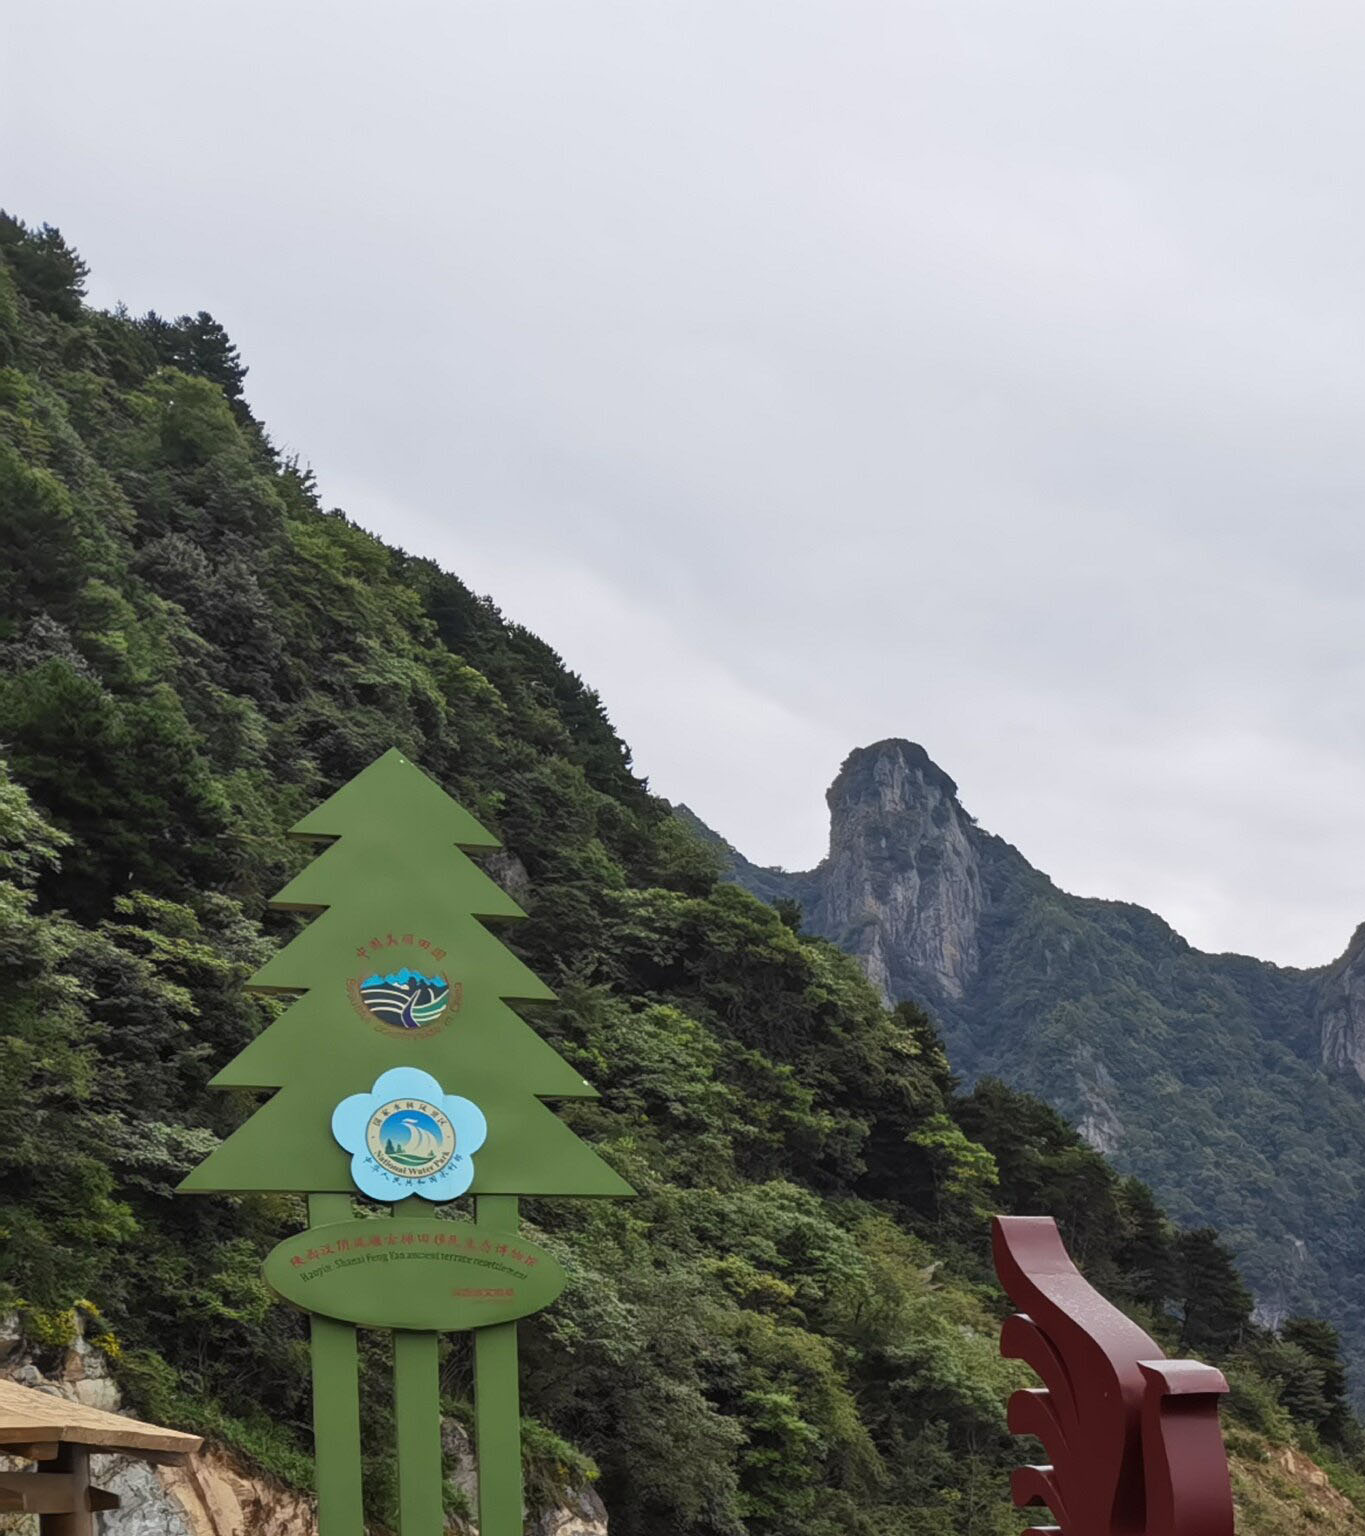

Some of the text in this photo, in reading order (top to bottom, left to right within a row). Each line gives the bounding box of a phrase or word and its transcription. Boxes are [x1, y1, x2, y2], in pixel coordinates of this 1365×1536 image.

[375, 1150, 450, 1176] National Water Park
